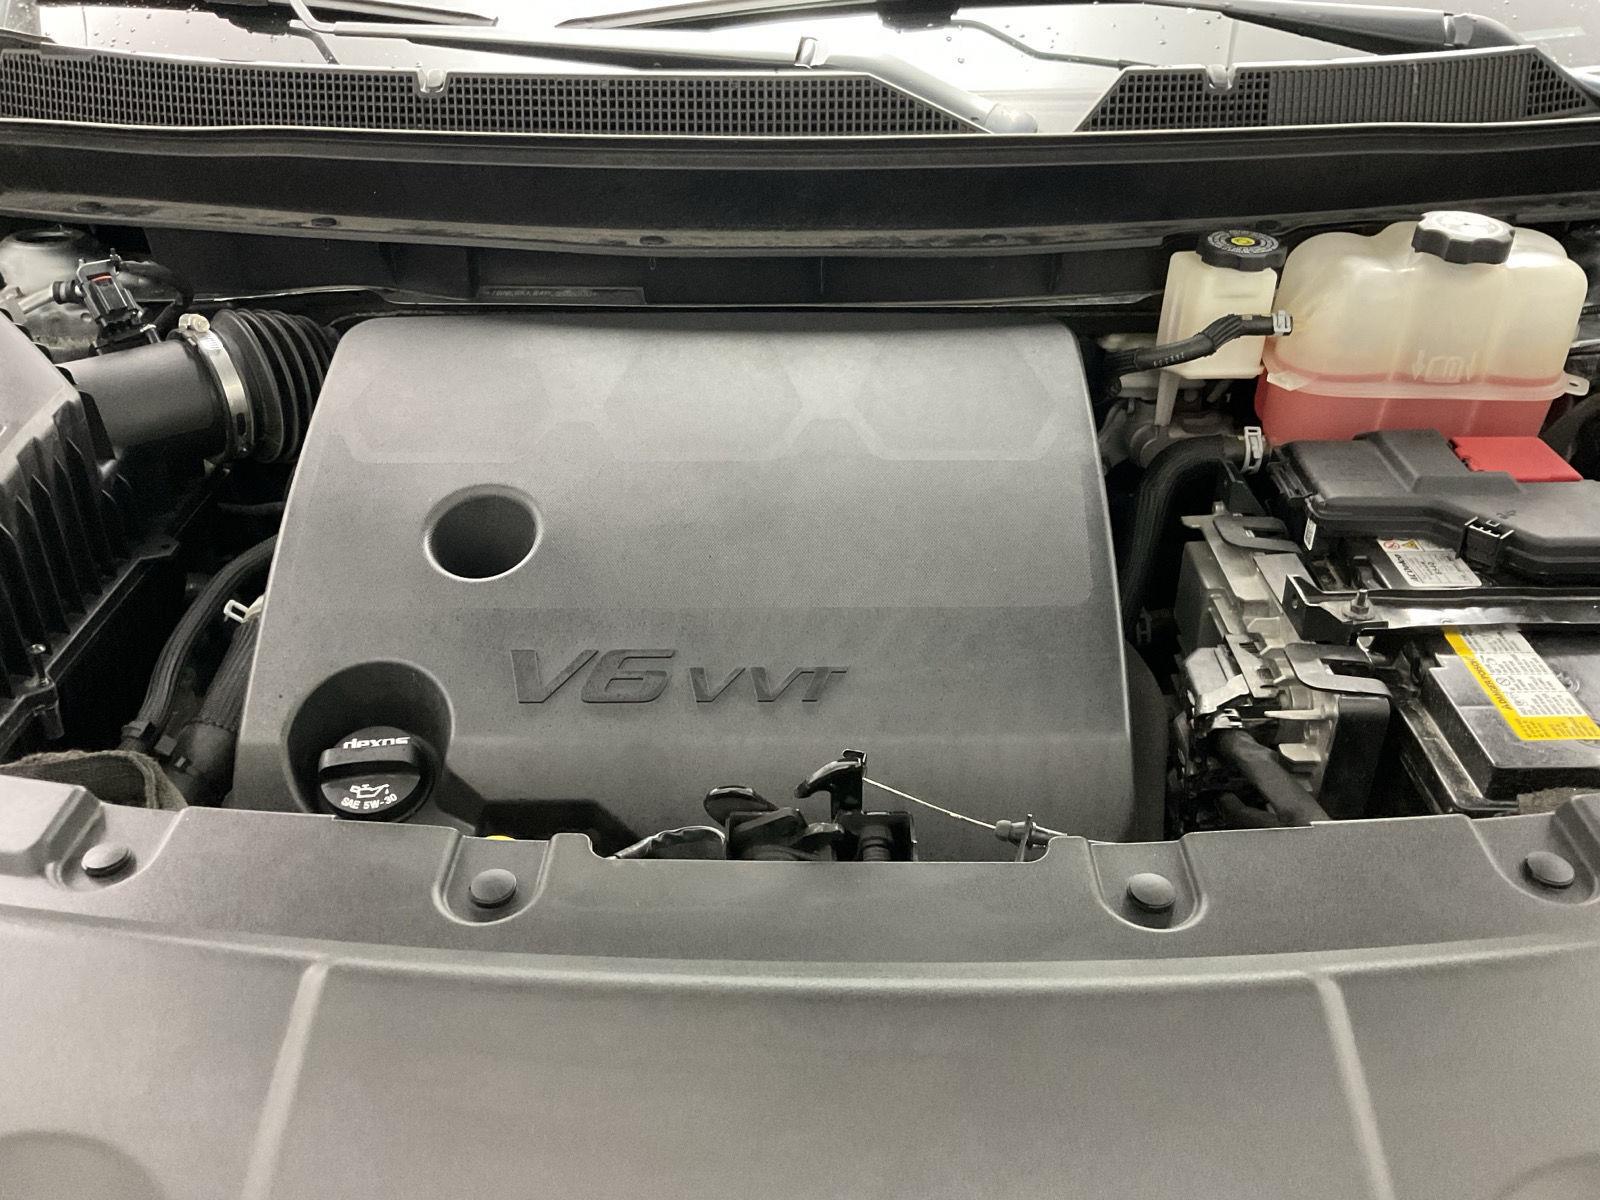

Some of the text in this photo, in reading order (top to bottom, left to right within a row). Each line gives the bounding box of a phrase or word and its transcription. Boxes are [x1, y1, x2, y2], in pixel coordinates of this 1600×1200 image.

[510, 649, 848, 703] V6 VVT
[341, 793, 398, 810] SAE 5W-30
